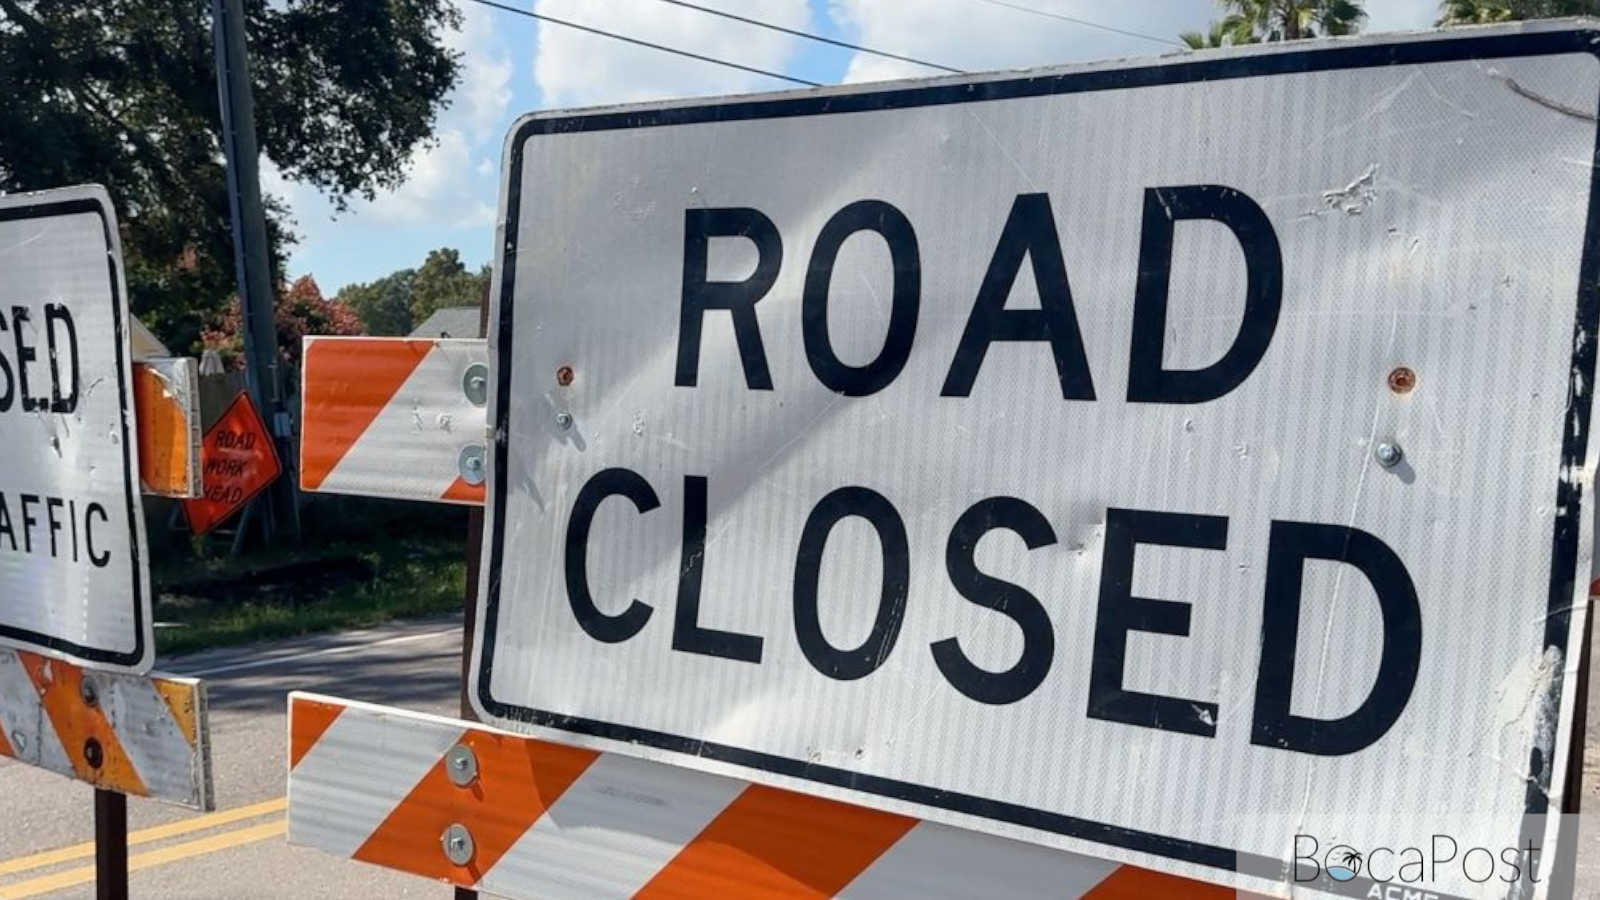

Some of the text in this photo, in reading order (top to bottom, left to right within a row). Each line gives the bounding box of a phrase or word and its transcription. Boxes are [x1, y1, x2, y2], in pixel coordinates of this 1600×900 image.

[674, 184, 1283, 404] ROAD
[206, 457, 249, 477] WORK
[215, 430, 257, 449] ROAD
[565, 467, 1422, 756] CLOSED
